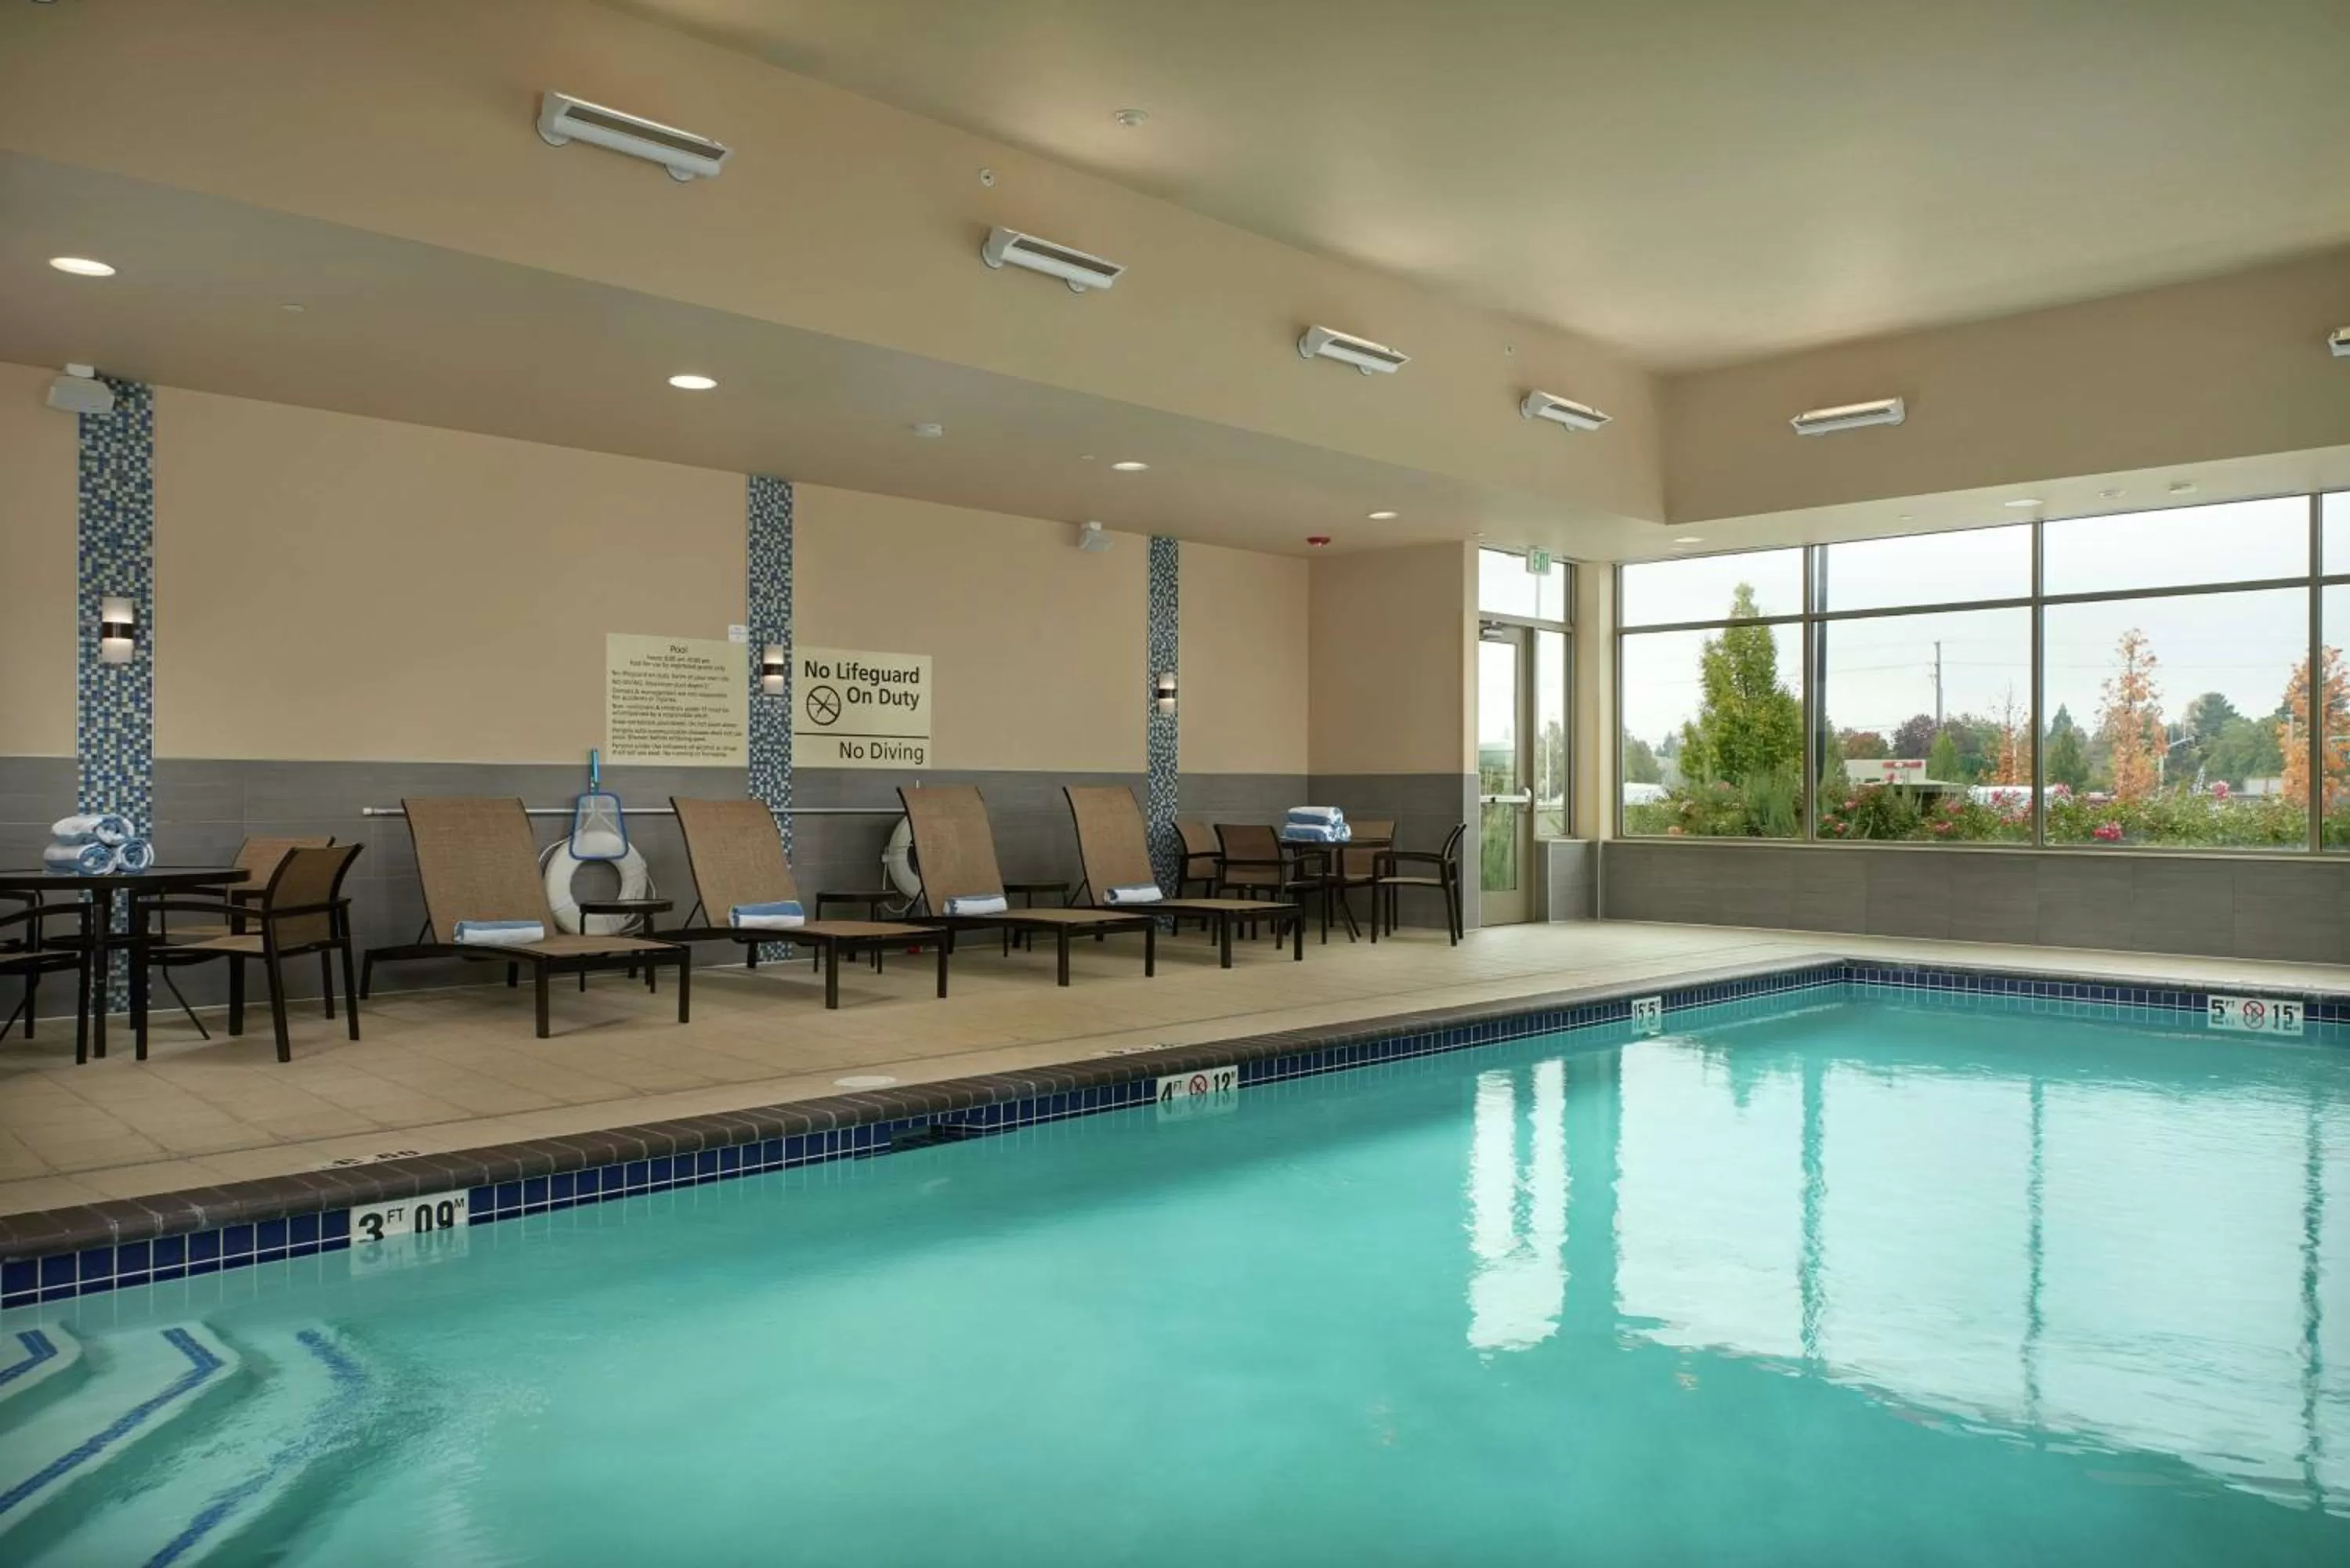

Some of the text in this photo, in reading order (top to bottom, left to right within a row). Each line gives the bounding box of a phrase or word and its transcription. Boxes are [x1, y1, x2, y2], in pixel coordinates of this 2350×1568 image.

[671, 645, 688, 654] Pool
[804, 660, 920, 686] No Lifeguard
[847, 686, 920, 710] On Duty
[839, 741, 924, 764] No Diving
[2273, 1003, 2294, 1021] 15
[1160, 1082, 1173, 1101] 4
[1213, 1071, 1231, 1093] 12
[357, 1212, 385, 1244] 3
[388, 1208, 406, 1223] FT
[414, 1200, 454, 1234] 09
